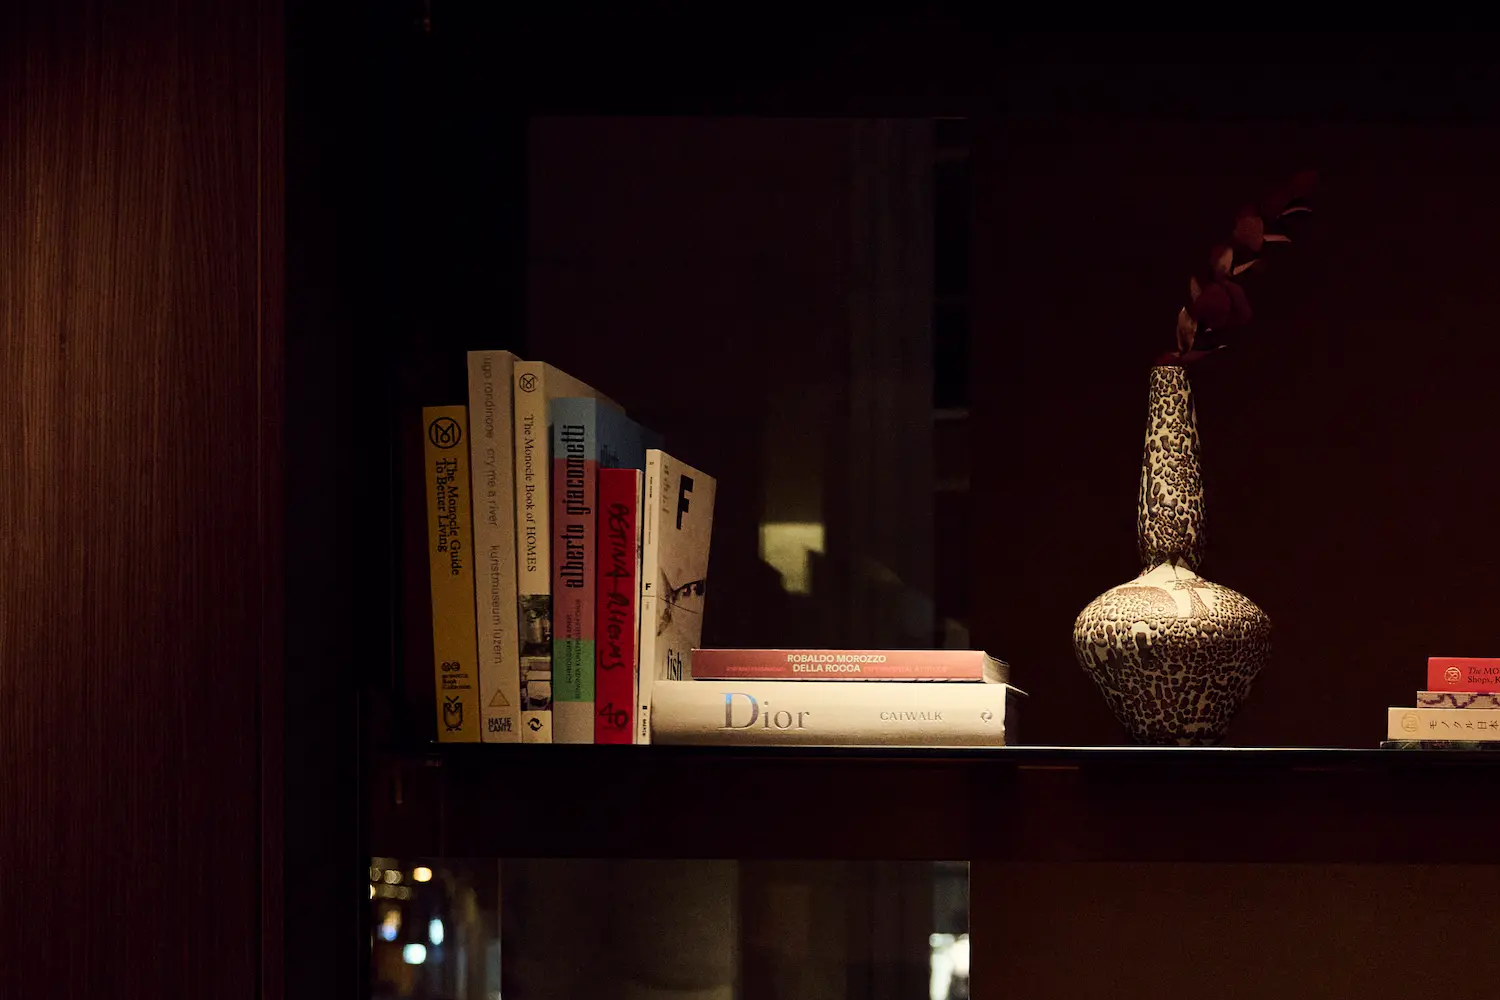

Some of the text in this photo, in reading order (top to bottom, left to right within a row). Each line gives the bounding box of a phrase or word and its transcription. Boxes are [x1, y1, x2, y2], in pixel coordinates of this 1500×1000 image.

[484, 382, 496, 439] rondinone
[435, 458, 448, 553] To Better Living
[524, 414, 537, 572] The Monocle Book of HOMES
[560, 424, 592, 589] alberto giacometti
[675, 473, 694, 531] F
[445, 457, 463, 576] The Monocle Guide
[488, 500, 500, 526] river
[489, 545, 502, 628] kunstmuseum
[645, 583, 652, 591] F
[493, 628, 504, 664] luzern
[787, 654, 887, 663] ROBALDO MOROZZO
[792, 663, 824, 673] DELLA
[825, 664, 861, 673] ROCCA
[1467, 676, 1493, 685] Shops,
[1468, 667, 1481, 675] The
[717, 691, 811, 731] Dior
[879, 711, 943, 722] CATWALK
